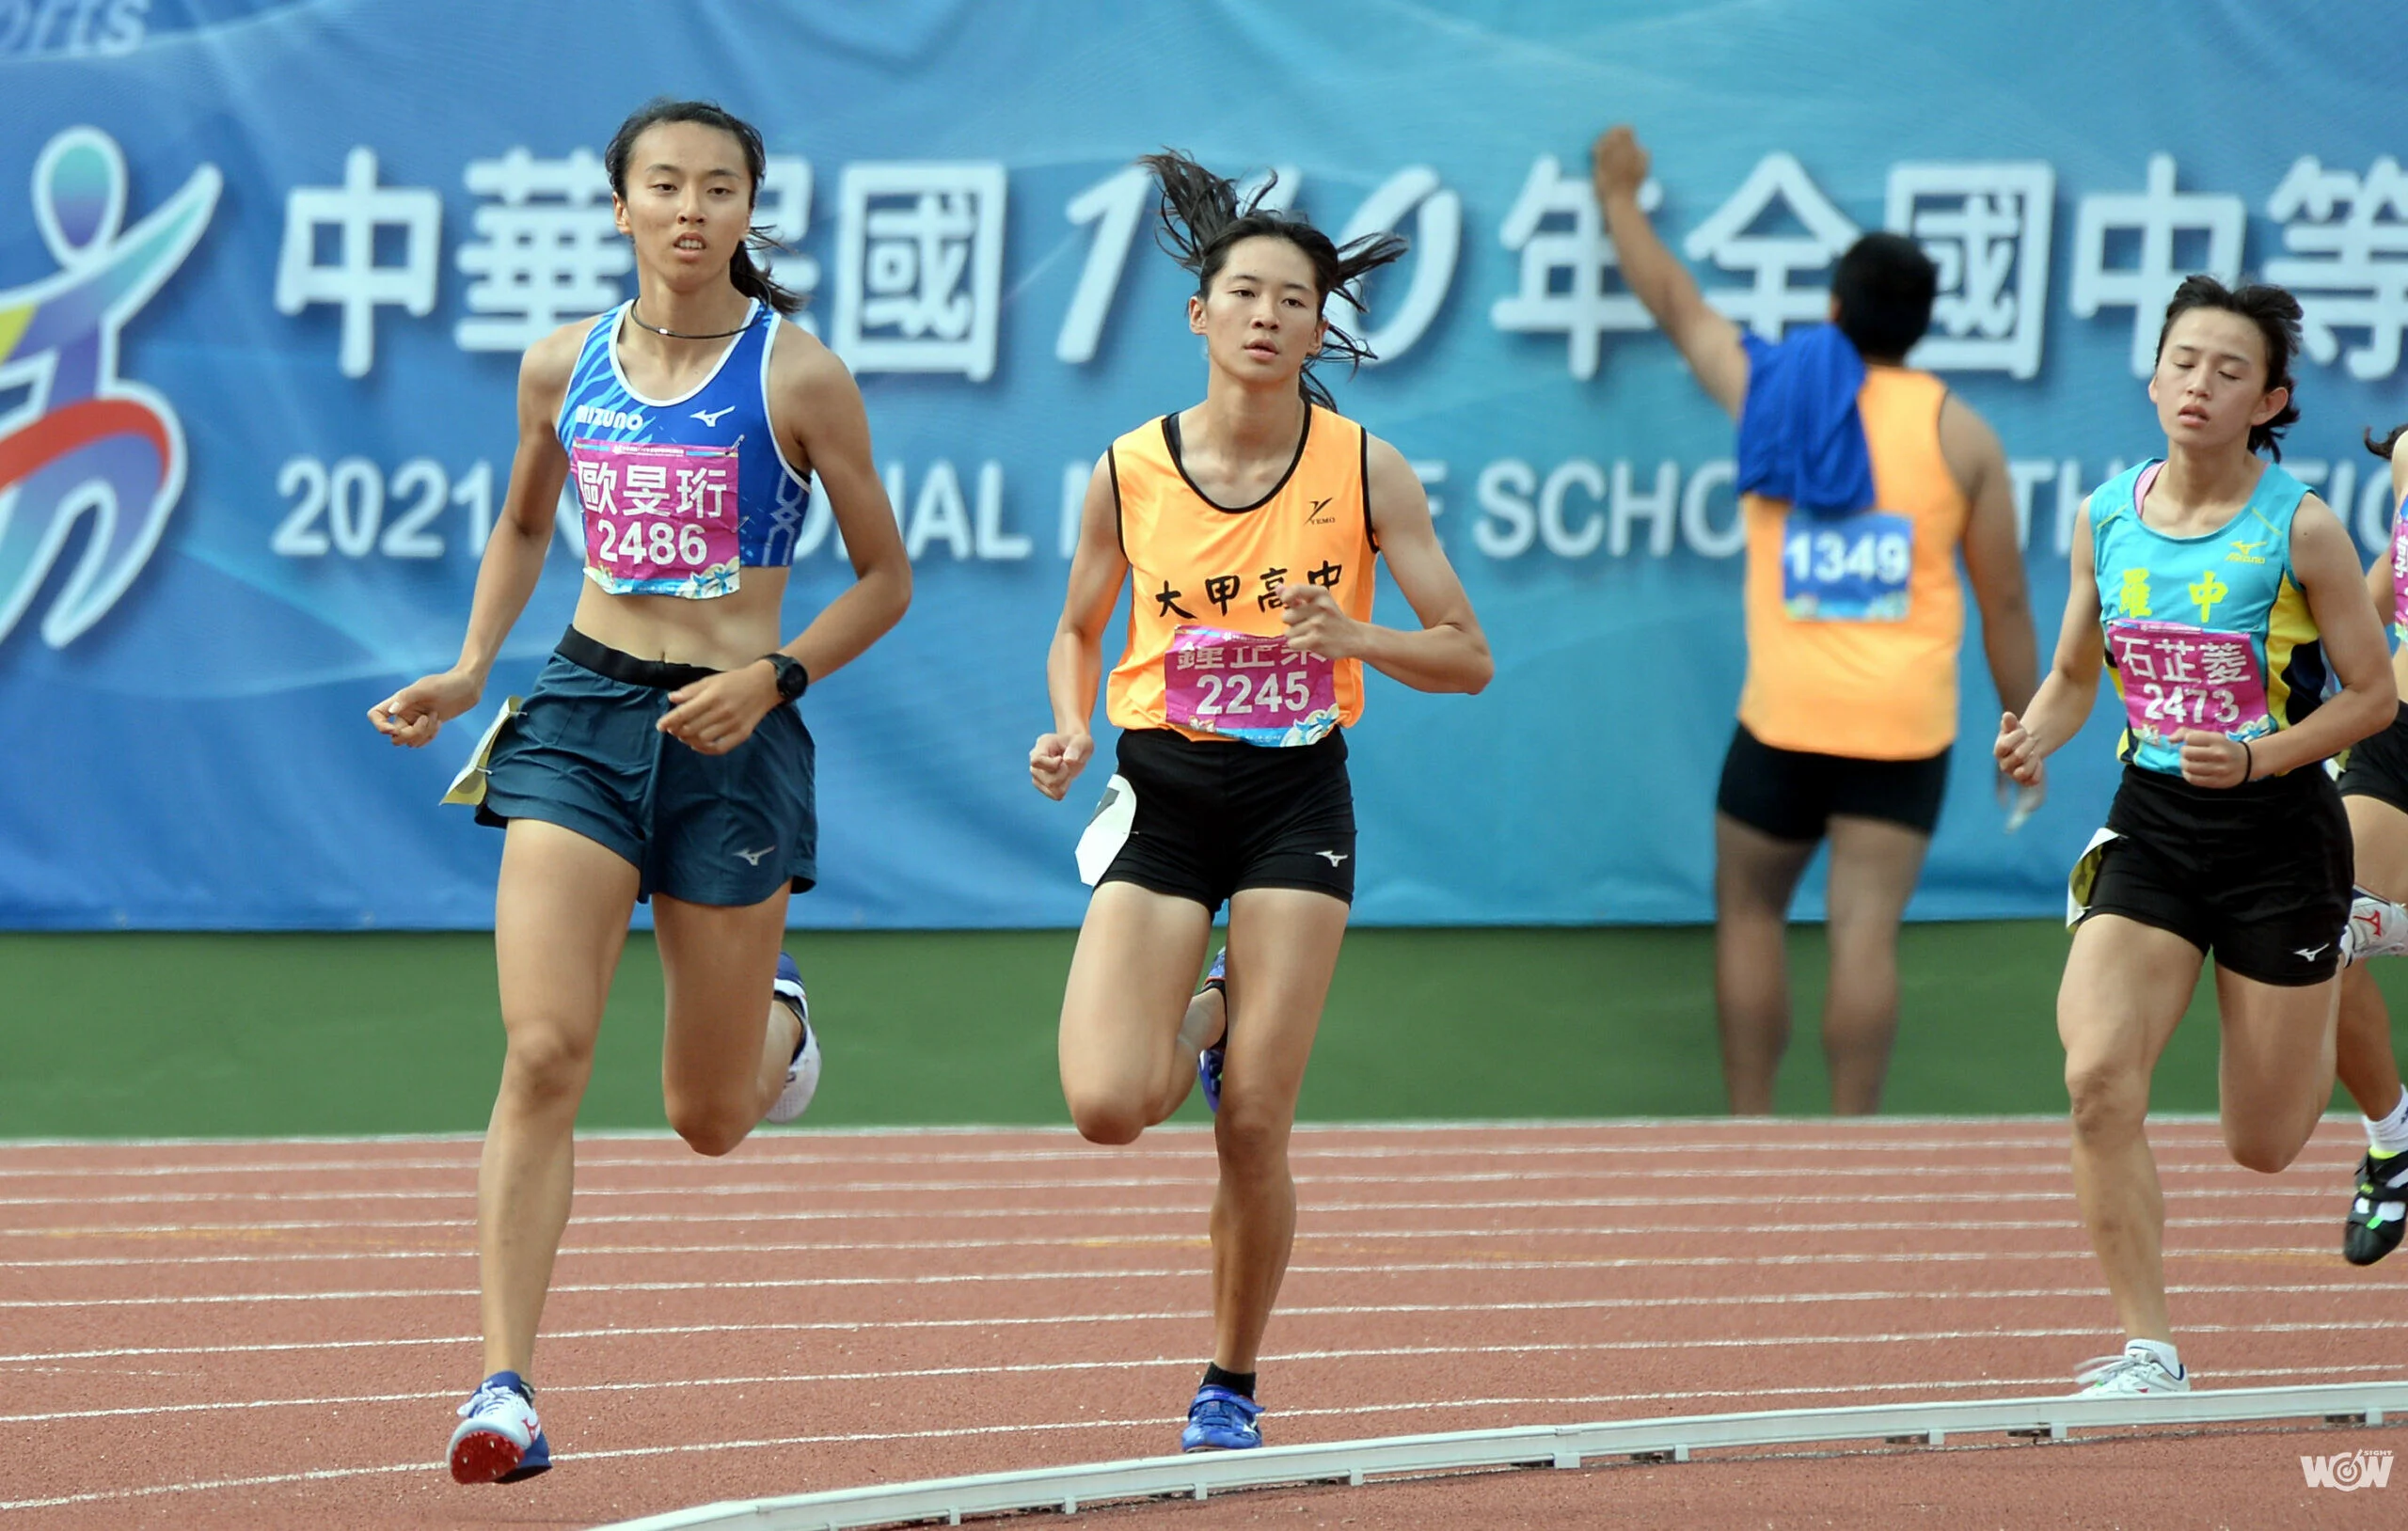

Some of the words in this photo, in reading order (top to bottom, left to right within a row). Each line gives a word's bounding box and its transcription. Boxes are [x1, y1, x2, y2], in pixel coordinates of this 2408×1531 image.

[575, 404, 643, 431] MIZUNO
[271, 456, 493, 558] 2021
[597, 518, 707, 565] 2486
[1785, 529, 1910, 585] 1349
[1155, 560, 1342, 620] 大甲高中
[2114, 635, 2251, 686] 石芷菱
[1196, 671, 1310, 715] 2245
[2143, 683, 2240, 723] 2473
